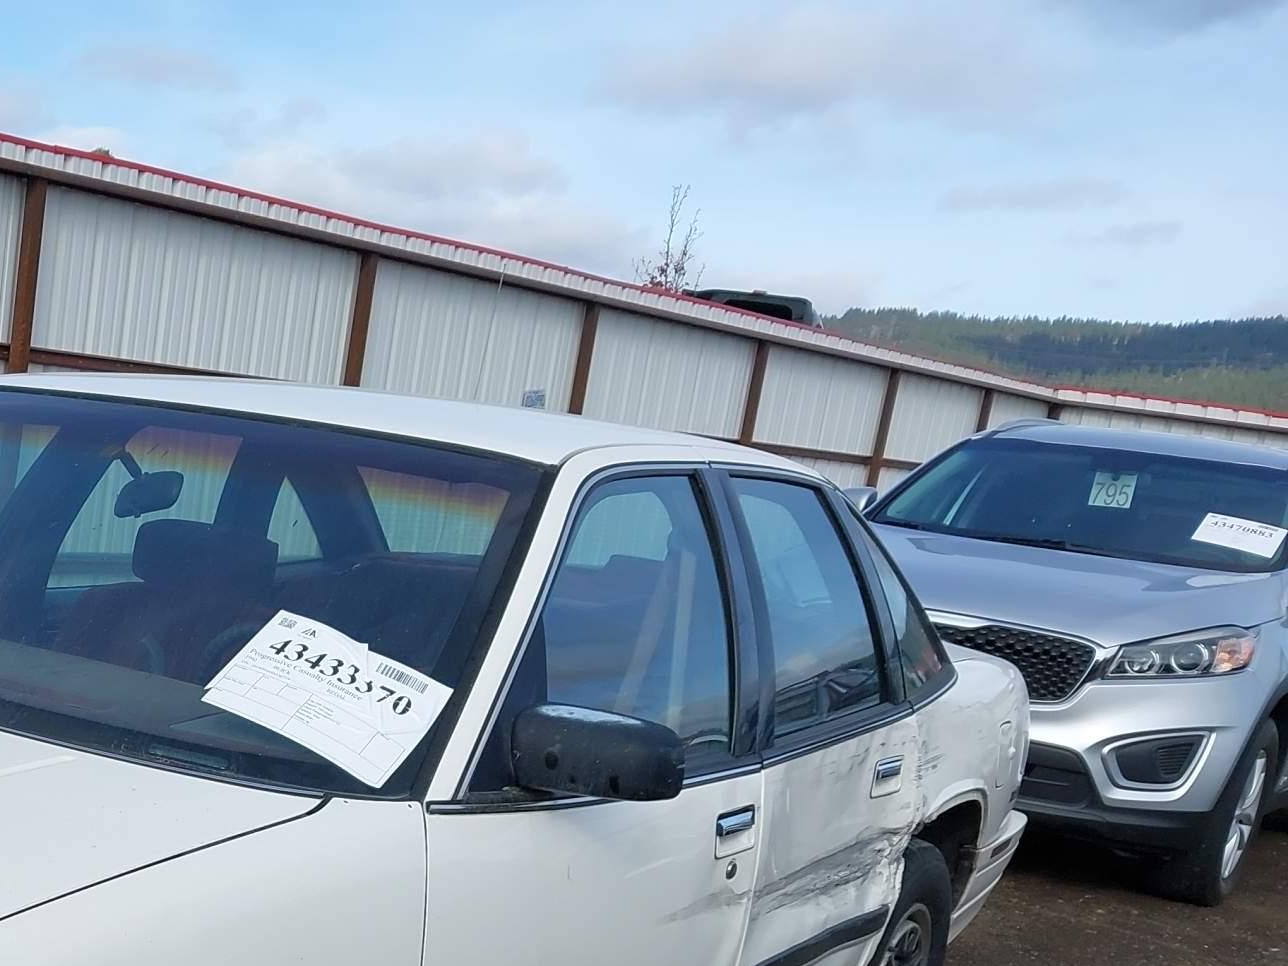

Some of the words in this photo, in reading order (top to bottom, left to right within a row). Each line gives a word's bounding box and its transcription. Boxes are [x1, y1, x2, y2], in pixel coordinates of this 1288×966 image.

[1092, 482, 1131, 507] 795
[293, 665, 327, 682] Casualty
[326, 679, 362, 701] Insurance
